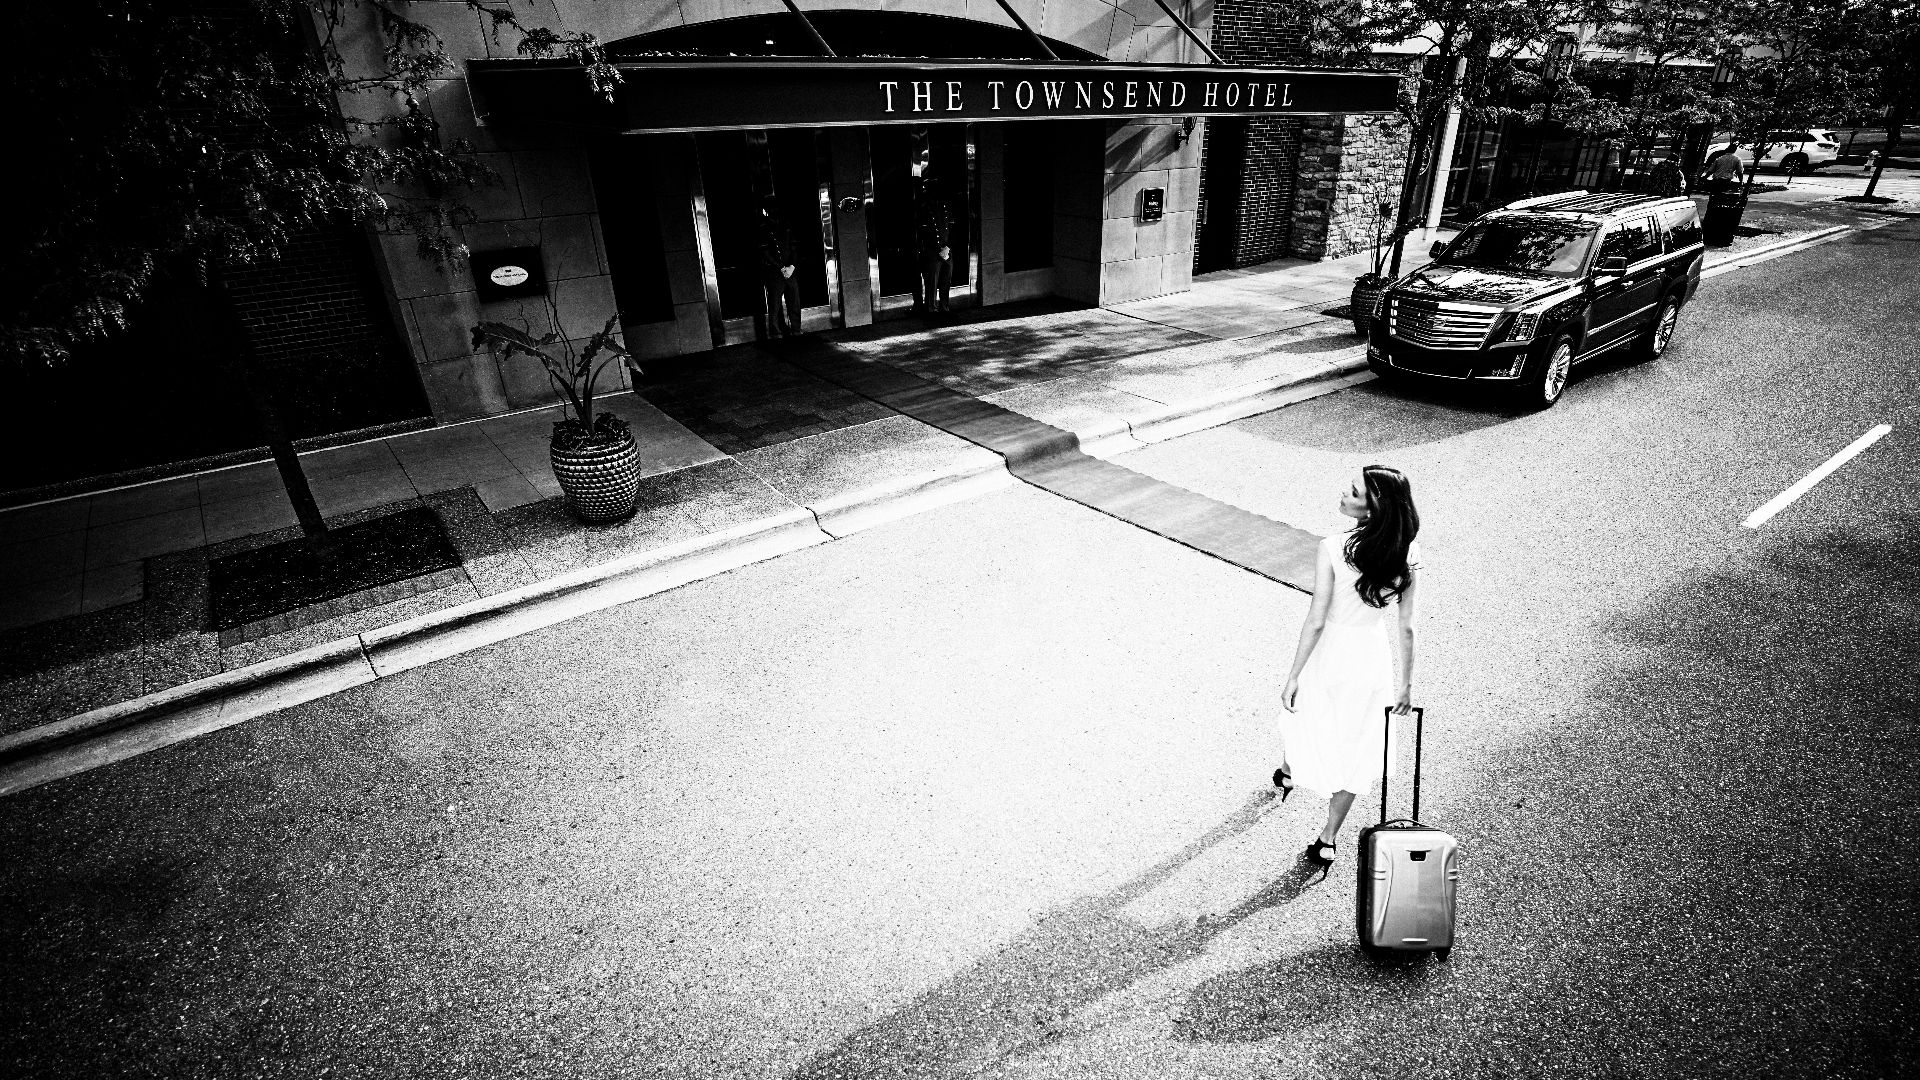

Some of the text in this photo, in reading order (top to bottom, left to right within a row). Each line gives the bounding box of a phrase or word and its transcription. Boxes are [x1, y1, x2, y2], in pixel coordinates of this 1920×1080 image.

[879, 80, 1293, 112] THE TOWNSEND HOTEL
